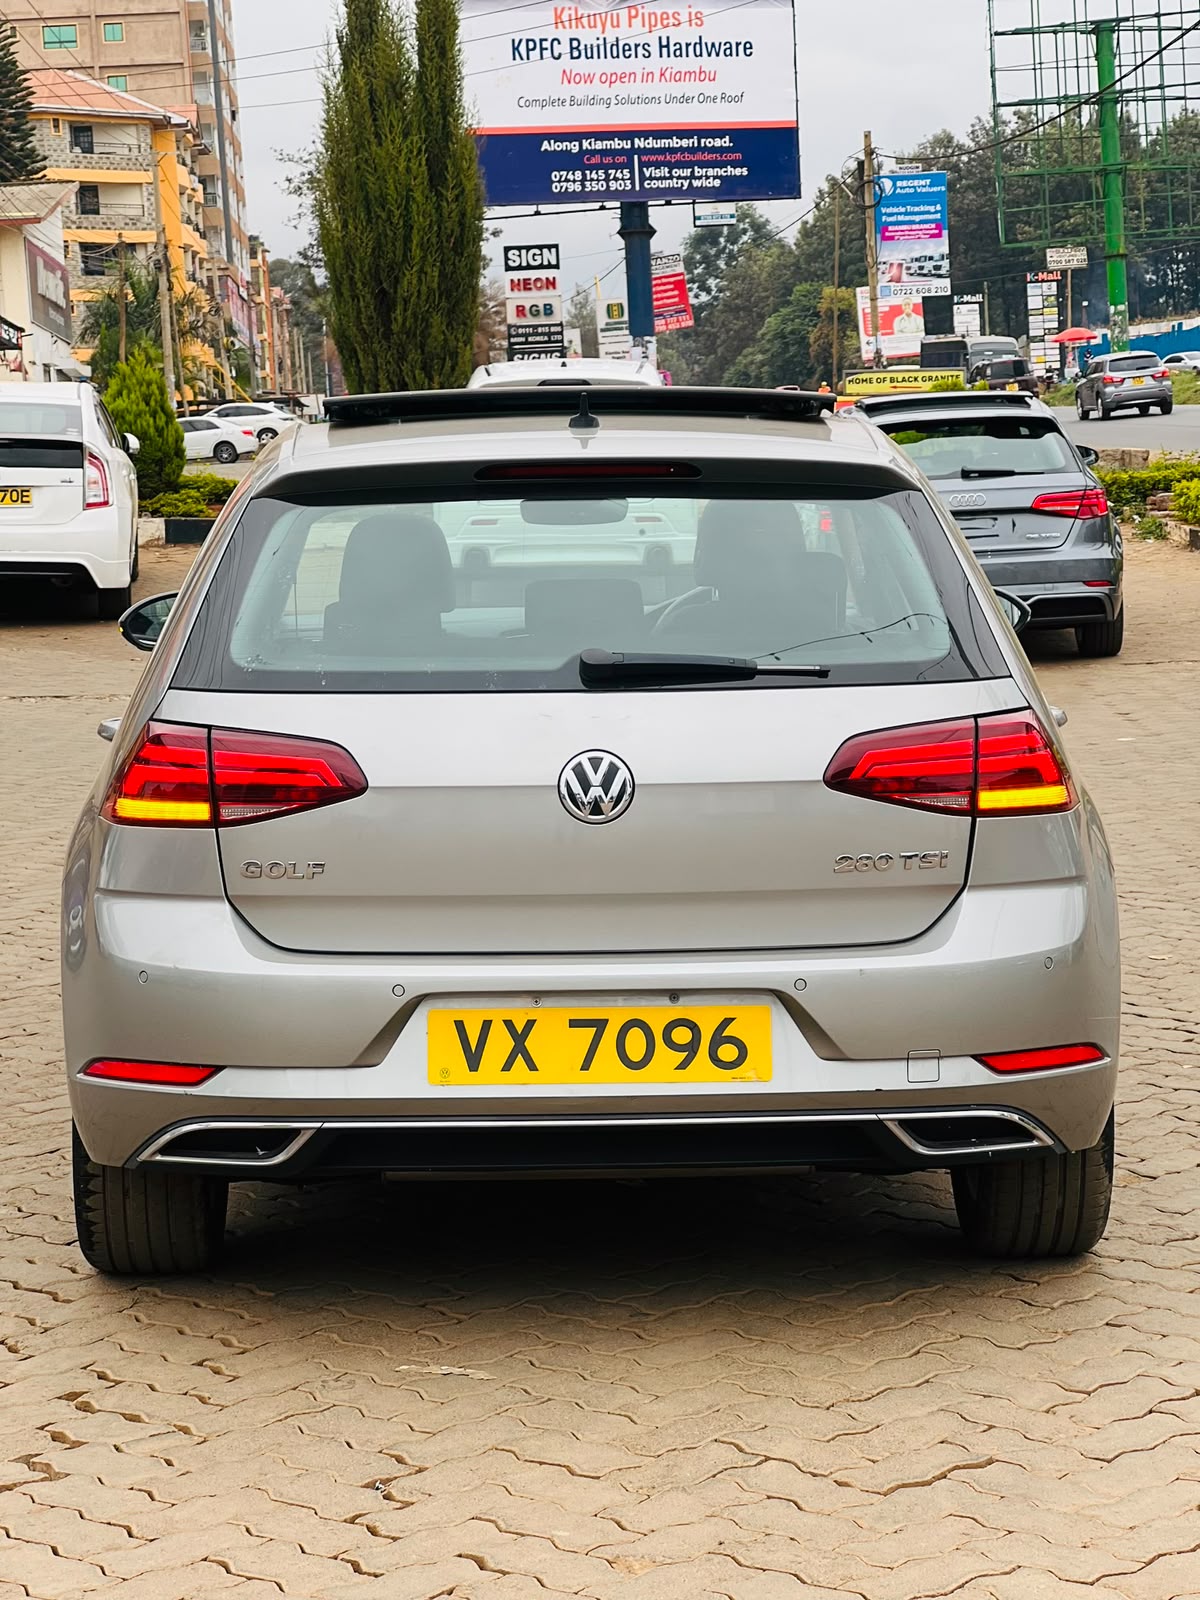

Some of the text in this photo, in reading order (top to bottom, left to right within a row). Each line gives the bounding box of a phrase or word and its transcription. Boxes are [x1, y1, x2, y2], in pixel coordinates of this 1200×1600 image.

[553, 4, 704, 34] Kikuyu Pipes is
[511, 35, 754, 60] KPFC Builders Hardware
[561, 65, 717, 88] Now open in Kiambu
[517, 91, 744, 110] Complete Building Solutions Under One Roof
[540, 135, 734, 153] Along Kiambu Ndumberi road.
[583, 154, 601, 164] Call
[603, 156, 613, 164] us
[640, 151, 742, 163] www.kpfcbuilders.com
[551, 169, 631, 182] 0748 145 745
[643, 165, 748, 178] Visit our branches
[551, 180, 632, 192] 0796 350 903
[644, 177, 721, 190] country wide
[896, 179, 931, 187] REGENT
[906, 204, 936, 213] Tracking
[882, 213, 941, 222] Fuel Management
[507, 248, 557, 267] SIGN
[1026, 271, 1062, 282] K-Mall
[510, 276, 556, 292] NEON
[892, 287, 914, 296] 0722
[916, 286, 932, 295] 608
[953, 294, 984, 303] K-Mall
[515, 303, 554, 318] RGB
[848, 374, 961, 385] HOME OF BLACK GRANITE
[834, 850, 949, 874] 280 TSI
[240, 860, 326, 879] GOLF
[453, 1017, 748, 1072] VX 7096
